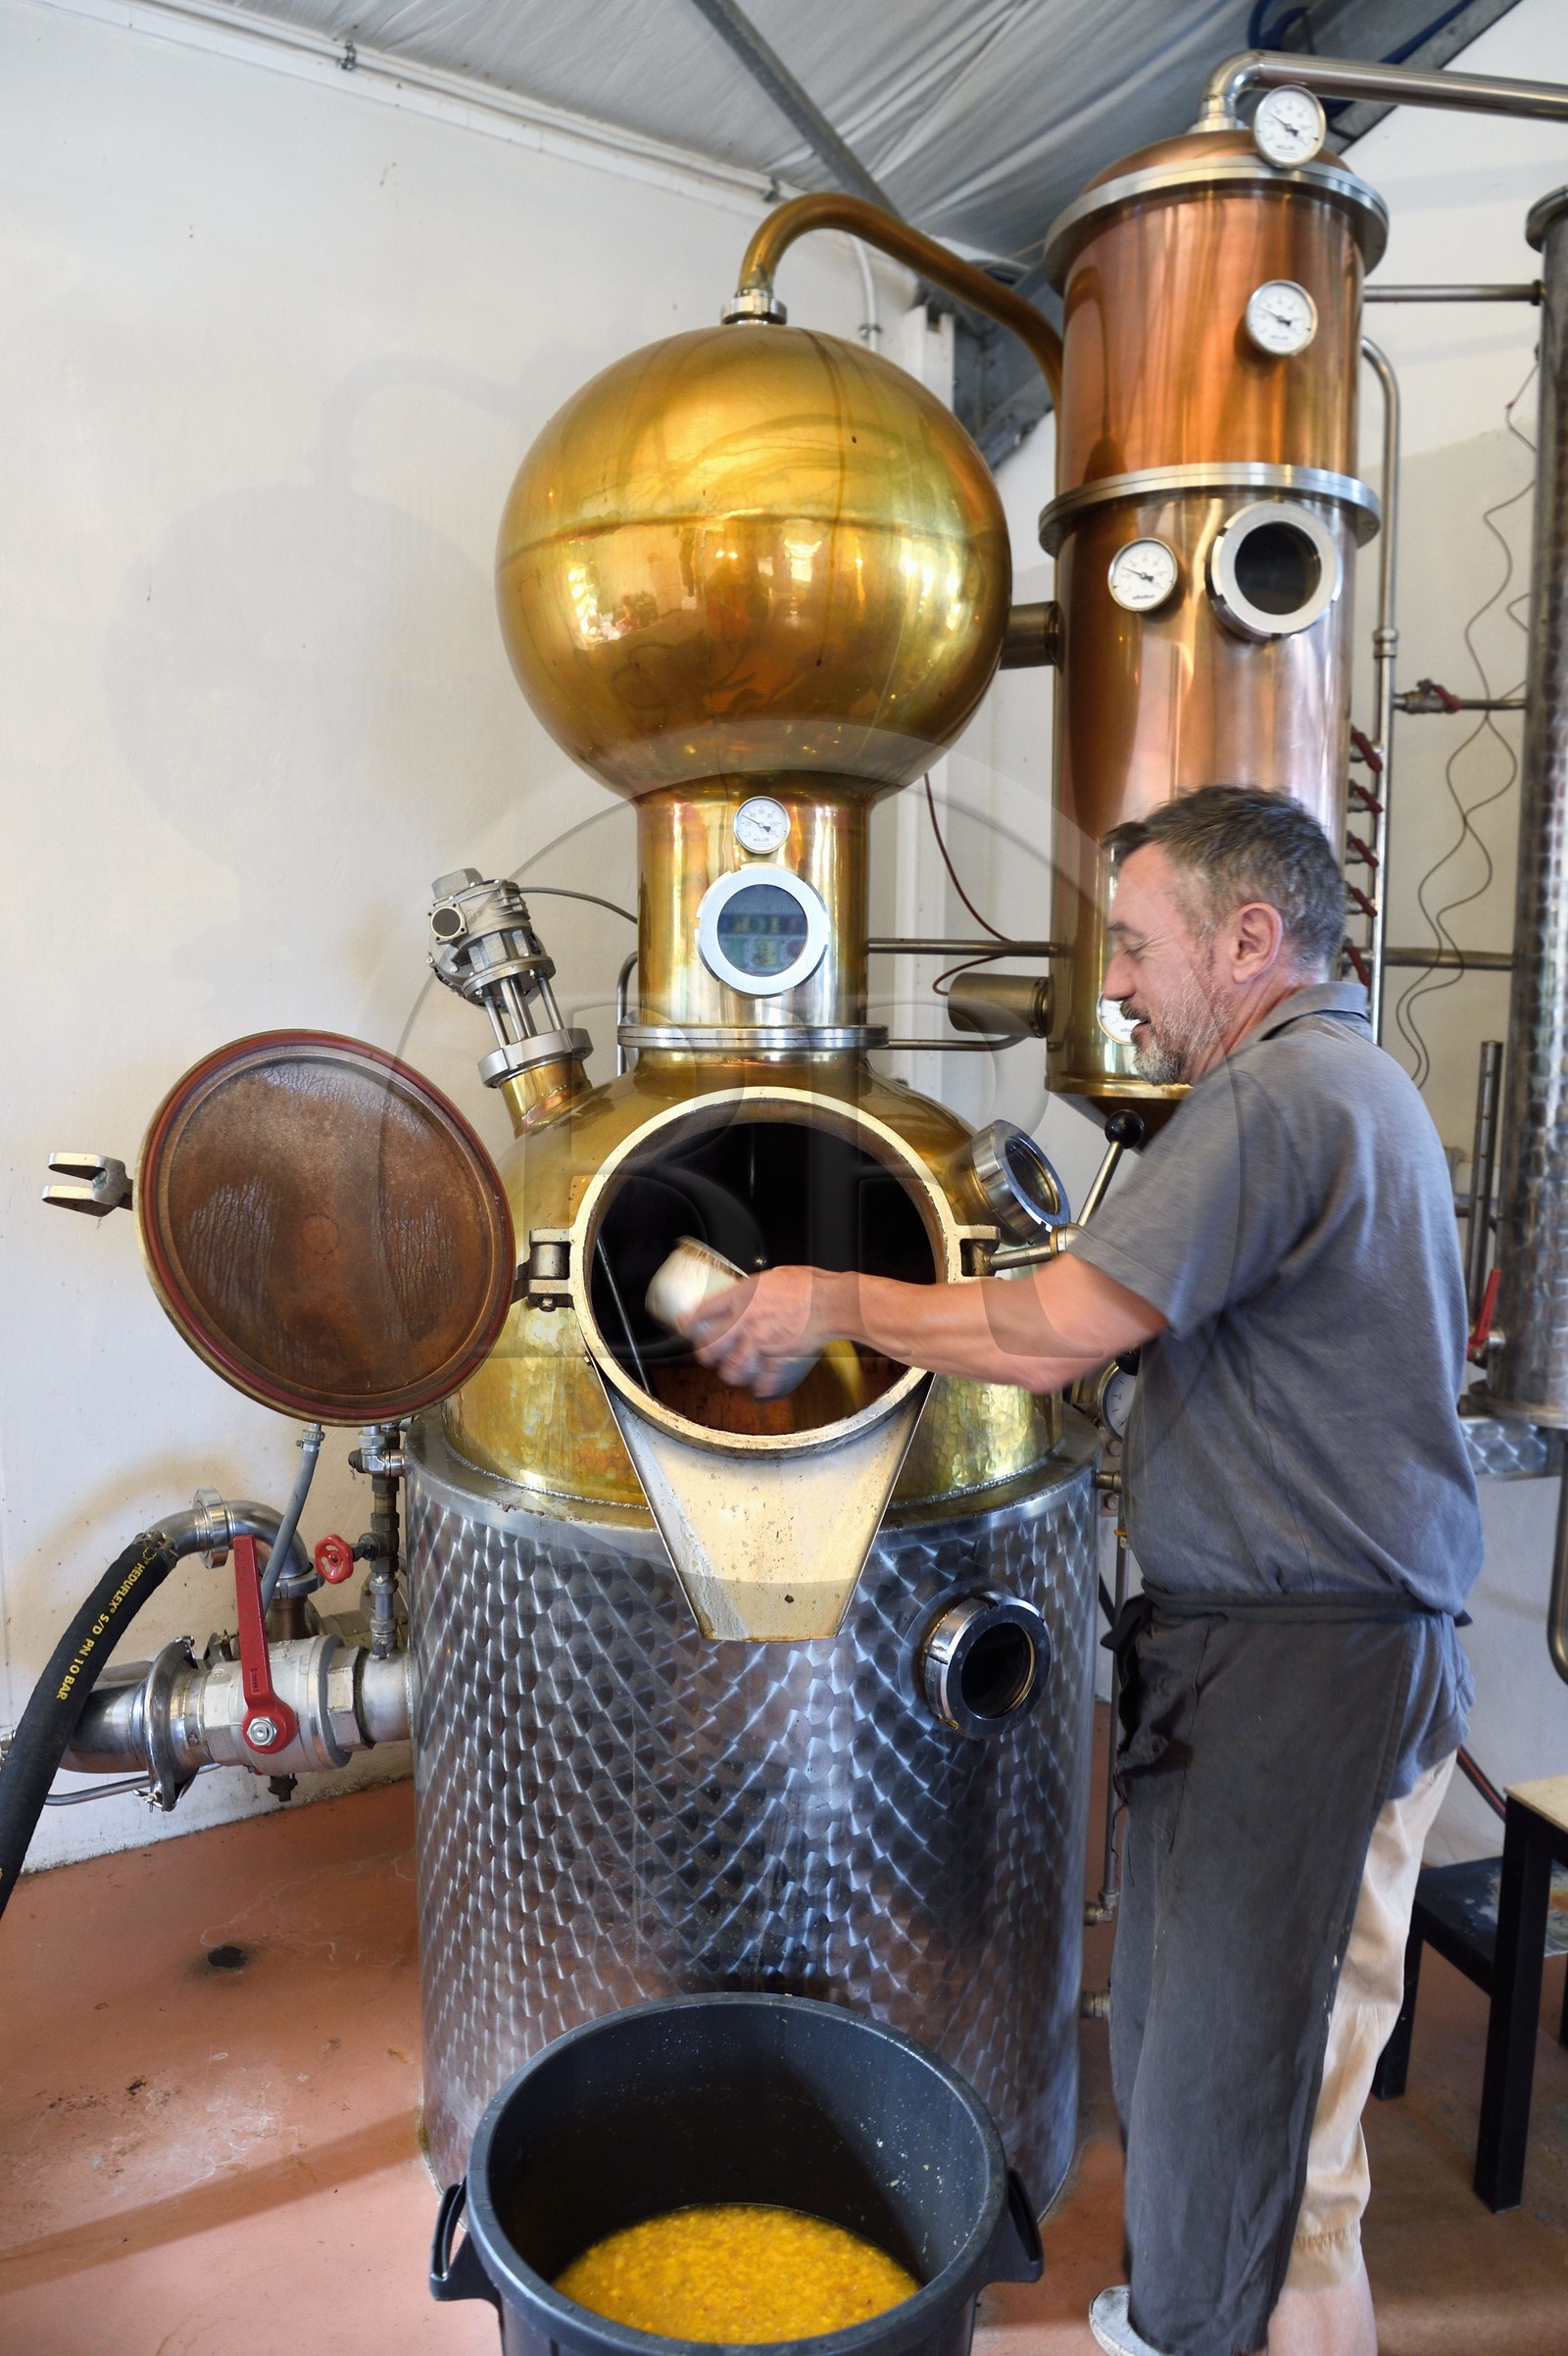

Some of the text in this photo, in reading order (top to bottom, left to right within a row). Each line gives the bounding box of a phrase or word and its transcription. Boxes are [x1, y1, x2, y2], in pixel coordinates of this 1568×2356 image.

[92, 1613, 110, 1636] S/D
[78, 1638, 95, 1656] PN
[69, 1658, 84, 1674] 10
[56, 1675, 75, 1700] BAR
